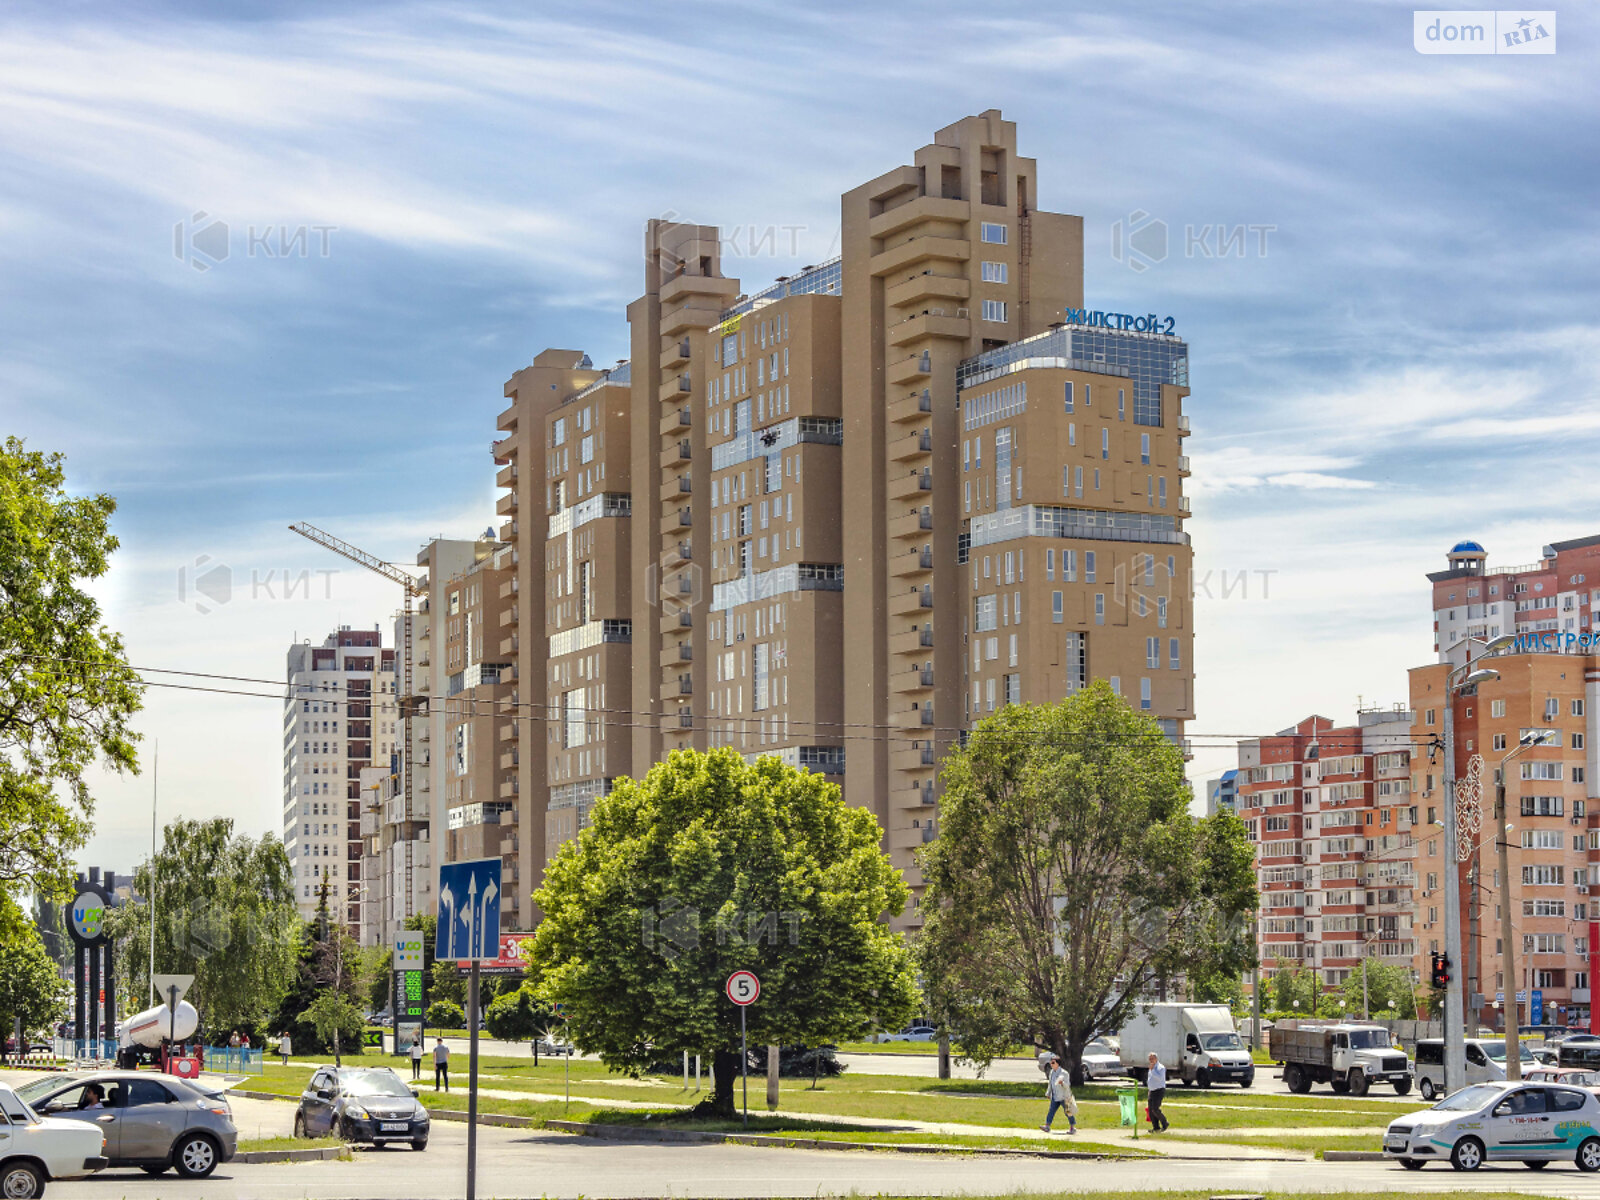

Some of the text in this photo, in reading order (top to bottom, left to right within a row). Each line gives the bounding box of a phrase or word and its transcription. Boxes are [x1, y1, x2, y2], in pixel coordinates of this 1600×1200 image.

[1065, 307, 1176, 336] ЖИЛСТРОЙ-2
[1508, 630, 1600, 650] ИЛСТРОЙ
[738, 979, 750, 997] 5
